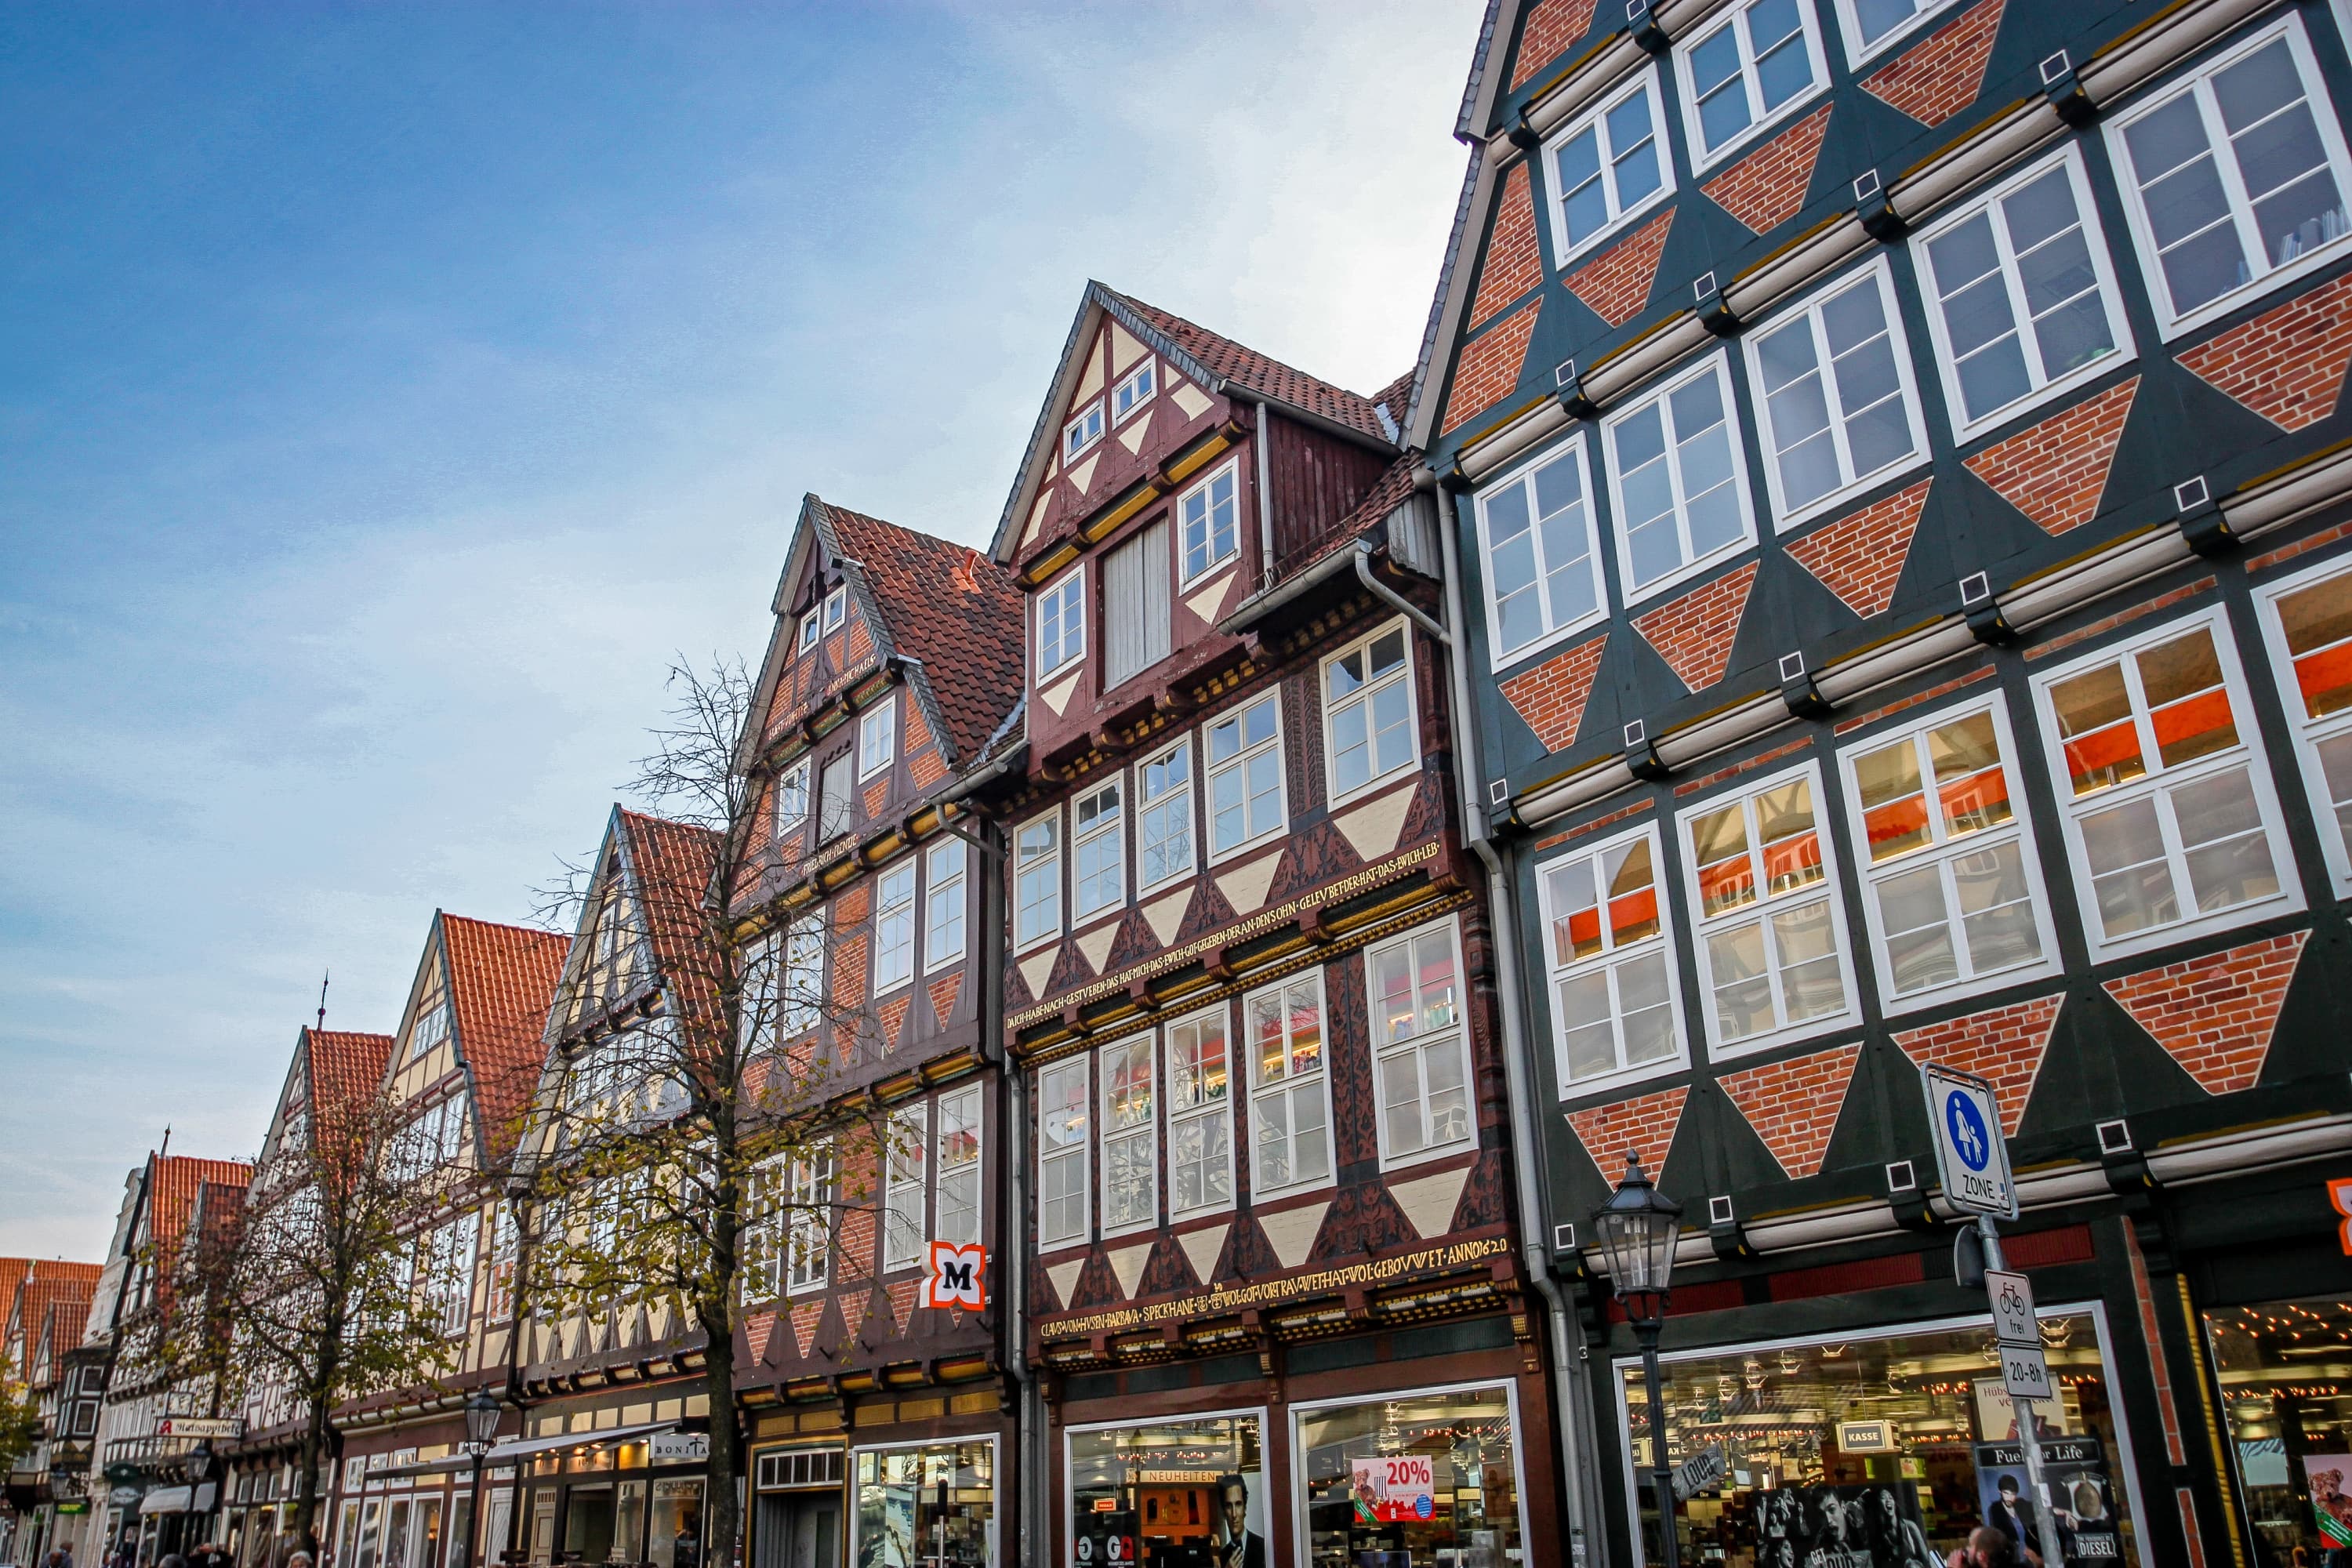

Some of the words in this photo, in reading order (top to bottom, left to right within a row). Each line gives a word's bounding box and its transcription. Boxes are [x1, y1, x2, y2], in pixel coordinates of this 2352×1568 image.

[1962, 1173, 1994, 1200] ZONE
[944, 1261, 972, 1291] M
[2009, 1319, 2024, 1334] frei
[2010, 1362, 2042, 1383] 20-8h
[1984, 1385, 2008, 1397] Hübs
[1848, 1432, 1879, 1442] KASSE
[656, 1437, 708, 1457] BONITA
[2055, 1445, 2083, 1461] Life
[1149, 1471, 1215, 1482] NEUHEITEN
[1386, 1460, 1430, 1486] 20%
[1107, 1535, 1134, 1561] GQ
[2079, 1541, 2114, 1556] DIESEL
